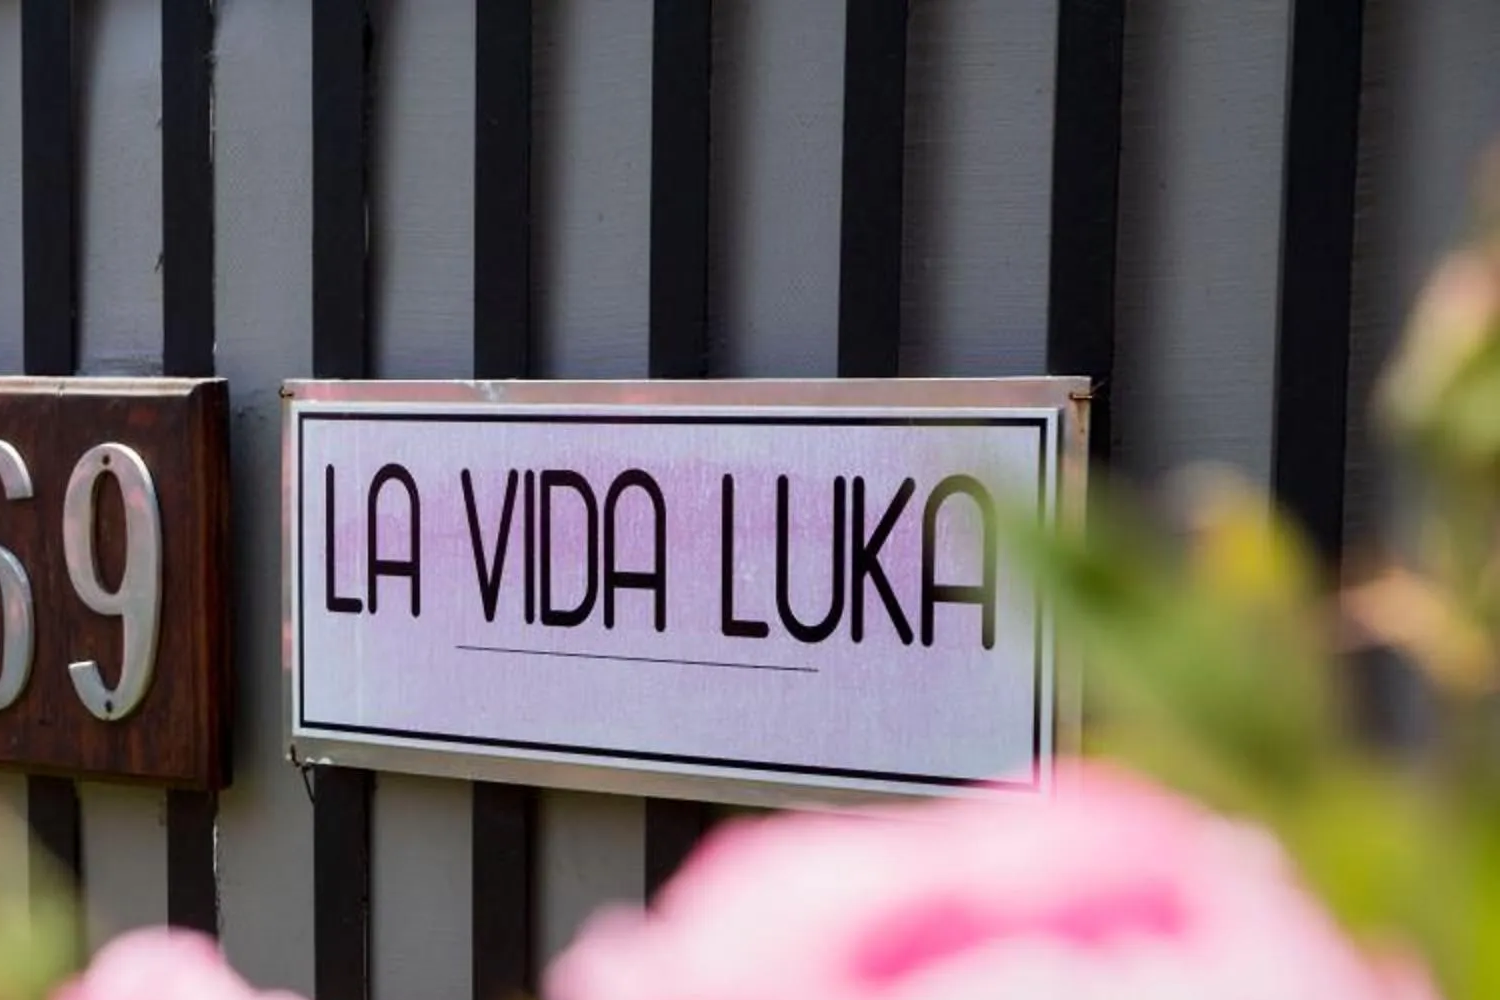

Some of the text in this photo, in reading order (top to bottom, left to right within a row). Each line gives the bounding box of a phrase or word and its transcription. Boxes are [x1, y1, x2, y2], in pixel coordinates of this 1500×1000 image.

[325, 463, 997, 651] LA VIDA LUKA
